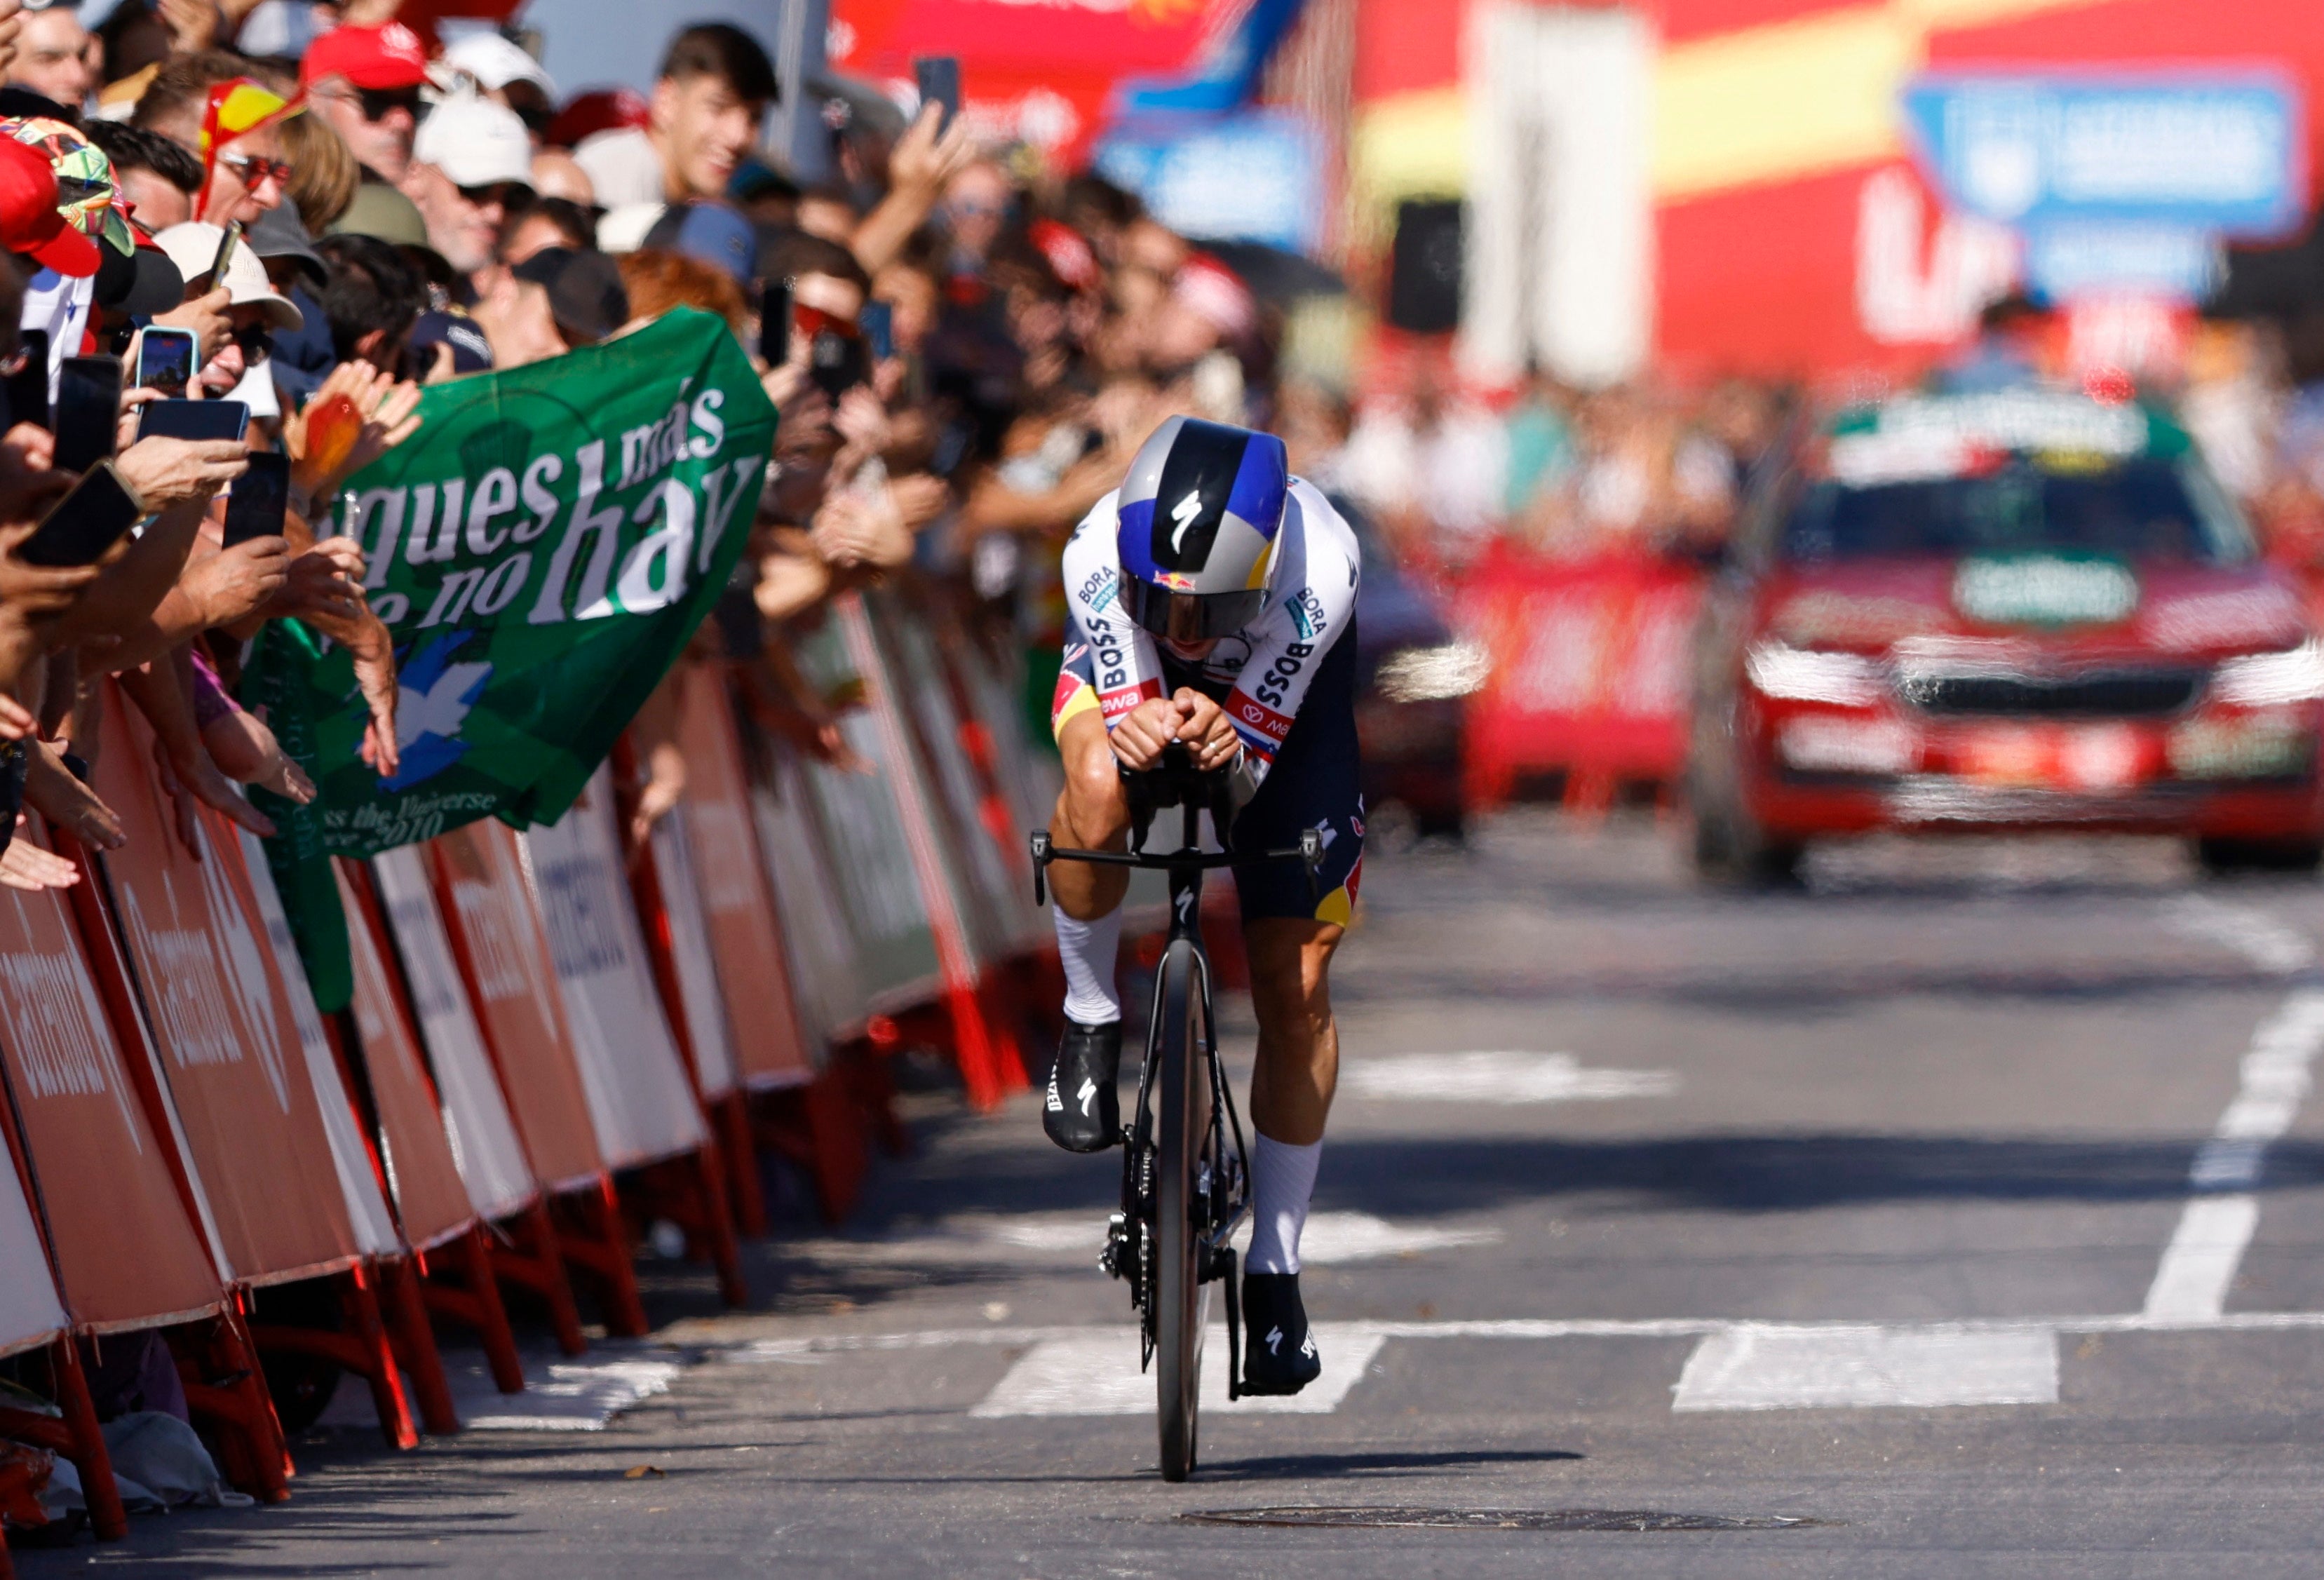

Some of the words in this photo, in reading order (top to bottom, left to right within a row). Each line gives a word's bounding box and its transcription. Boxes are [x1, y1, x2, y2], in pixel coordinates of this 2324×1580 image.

[318, 454, 561, 590] ques
[614, 376, 725, 491] más
[417, 552, 532, 629] no
[1079, 565, 1116, 605] BORA
[1296, 587, 1327, 635] BORA
[1086, 617, 1127, 689] BOSS
[1256, 643, 1314, 708] BOSS
